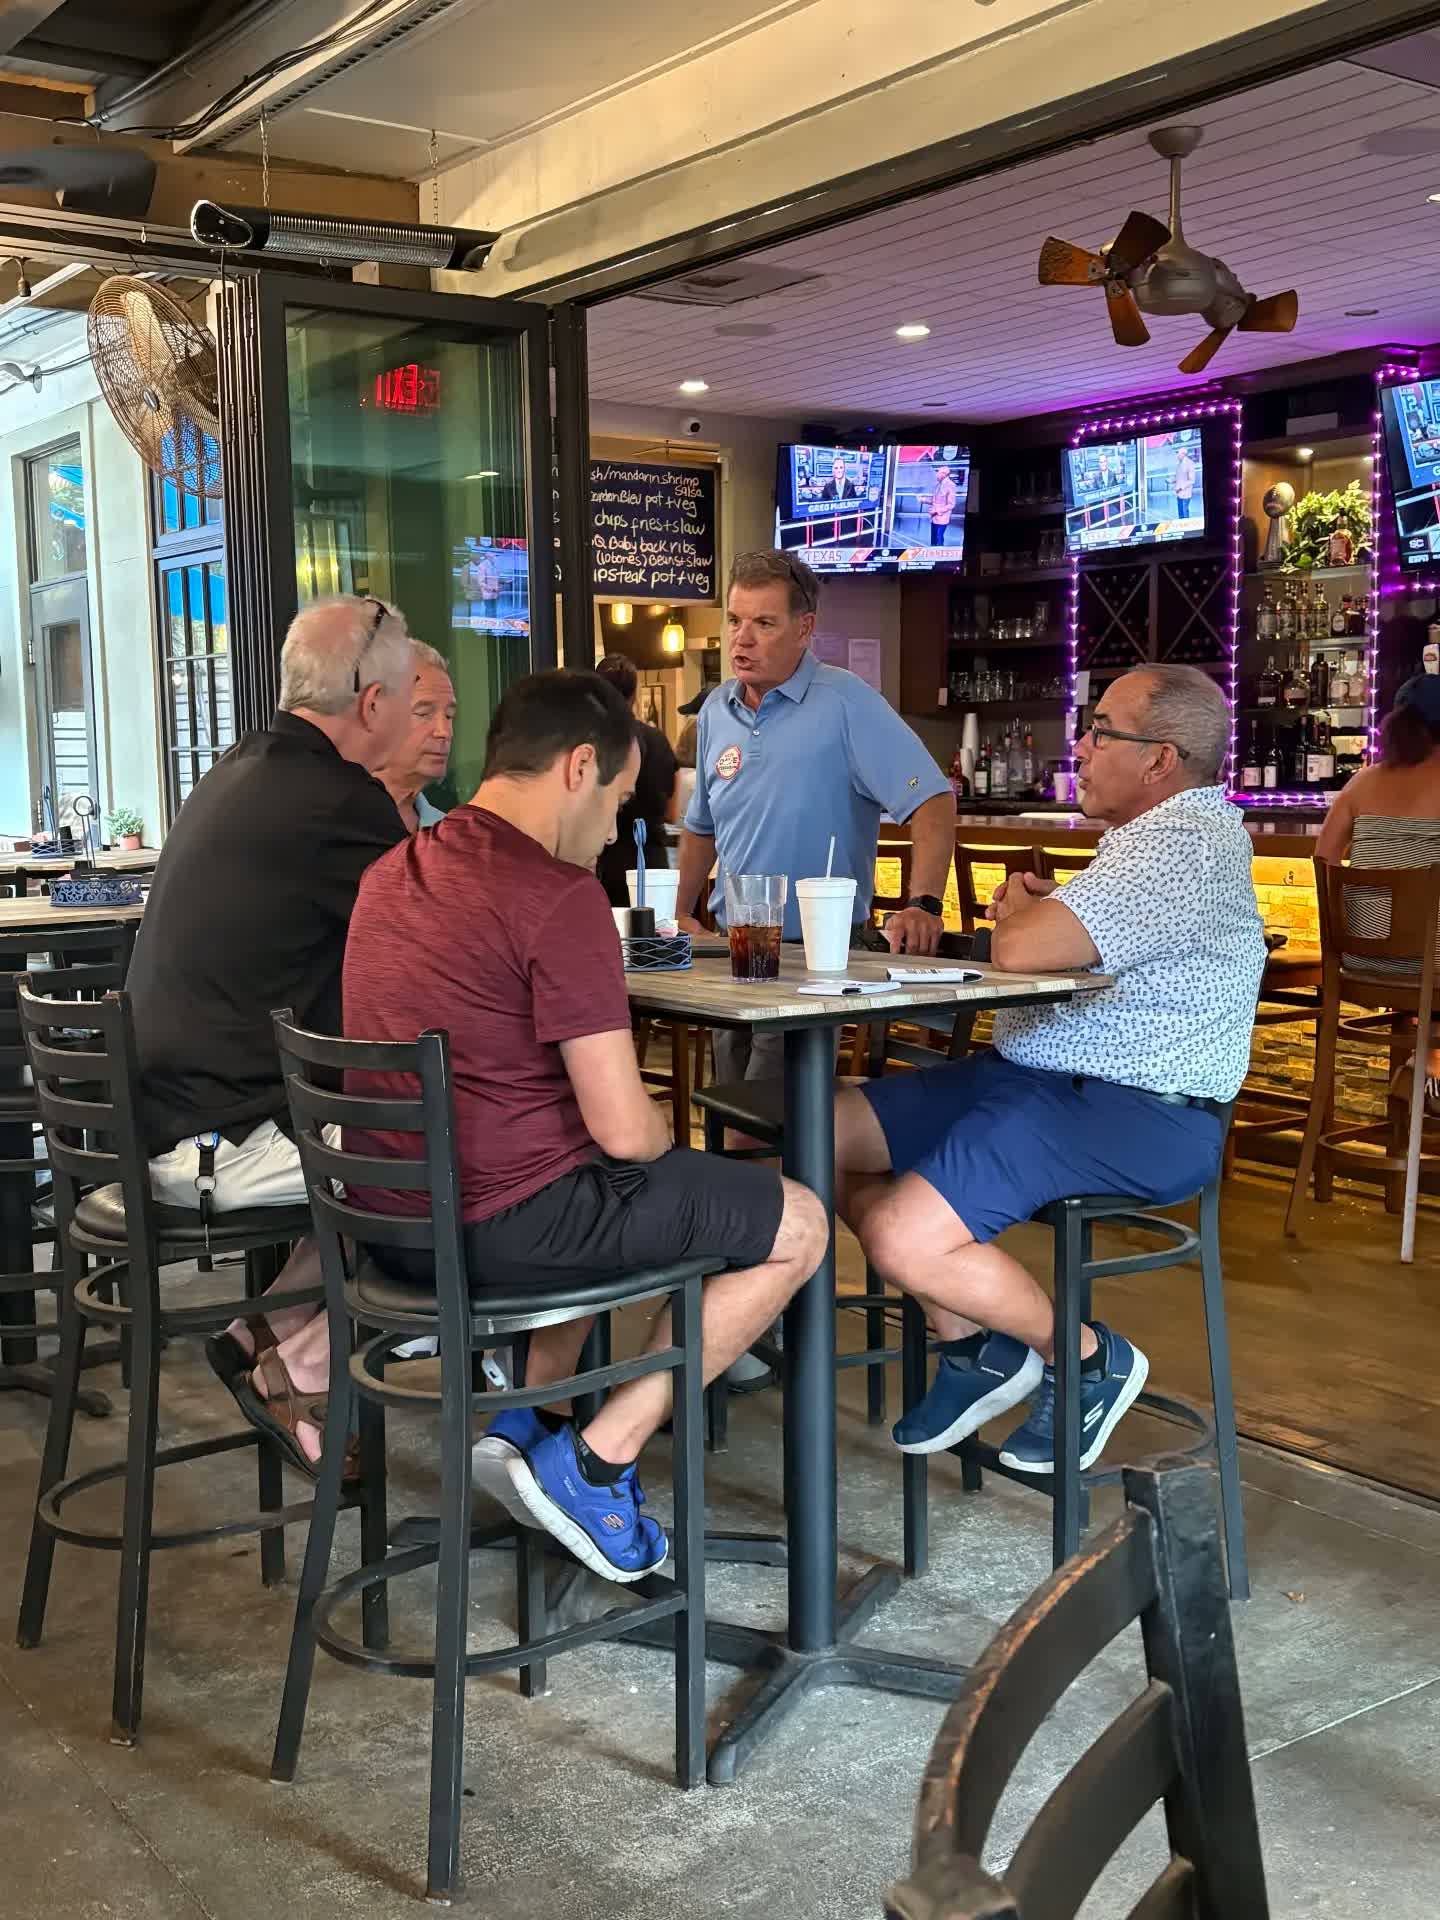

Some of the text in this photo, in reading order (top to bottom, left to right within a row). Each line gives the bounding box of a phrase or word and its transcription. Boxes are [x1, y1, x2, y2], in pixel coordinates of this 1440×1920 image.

[645, 491, 664, 512] pot
[594, 508, 628, 531] chips
[608, 536, 637, 555] Baby
[640, 537, 669, 553] back
[670, 540, 697, 555] ribs
[805, 550, 842, 562] TEXAS
[651, 567, 676, 590] pot
